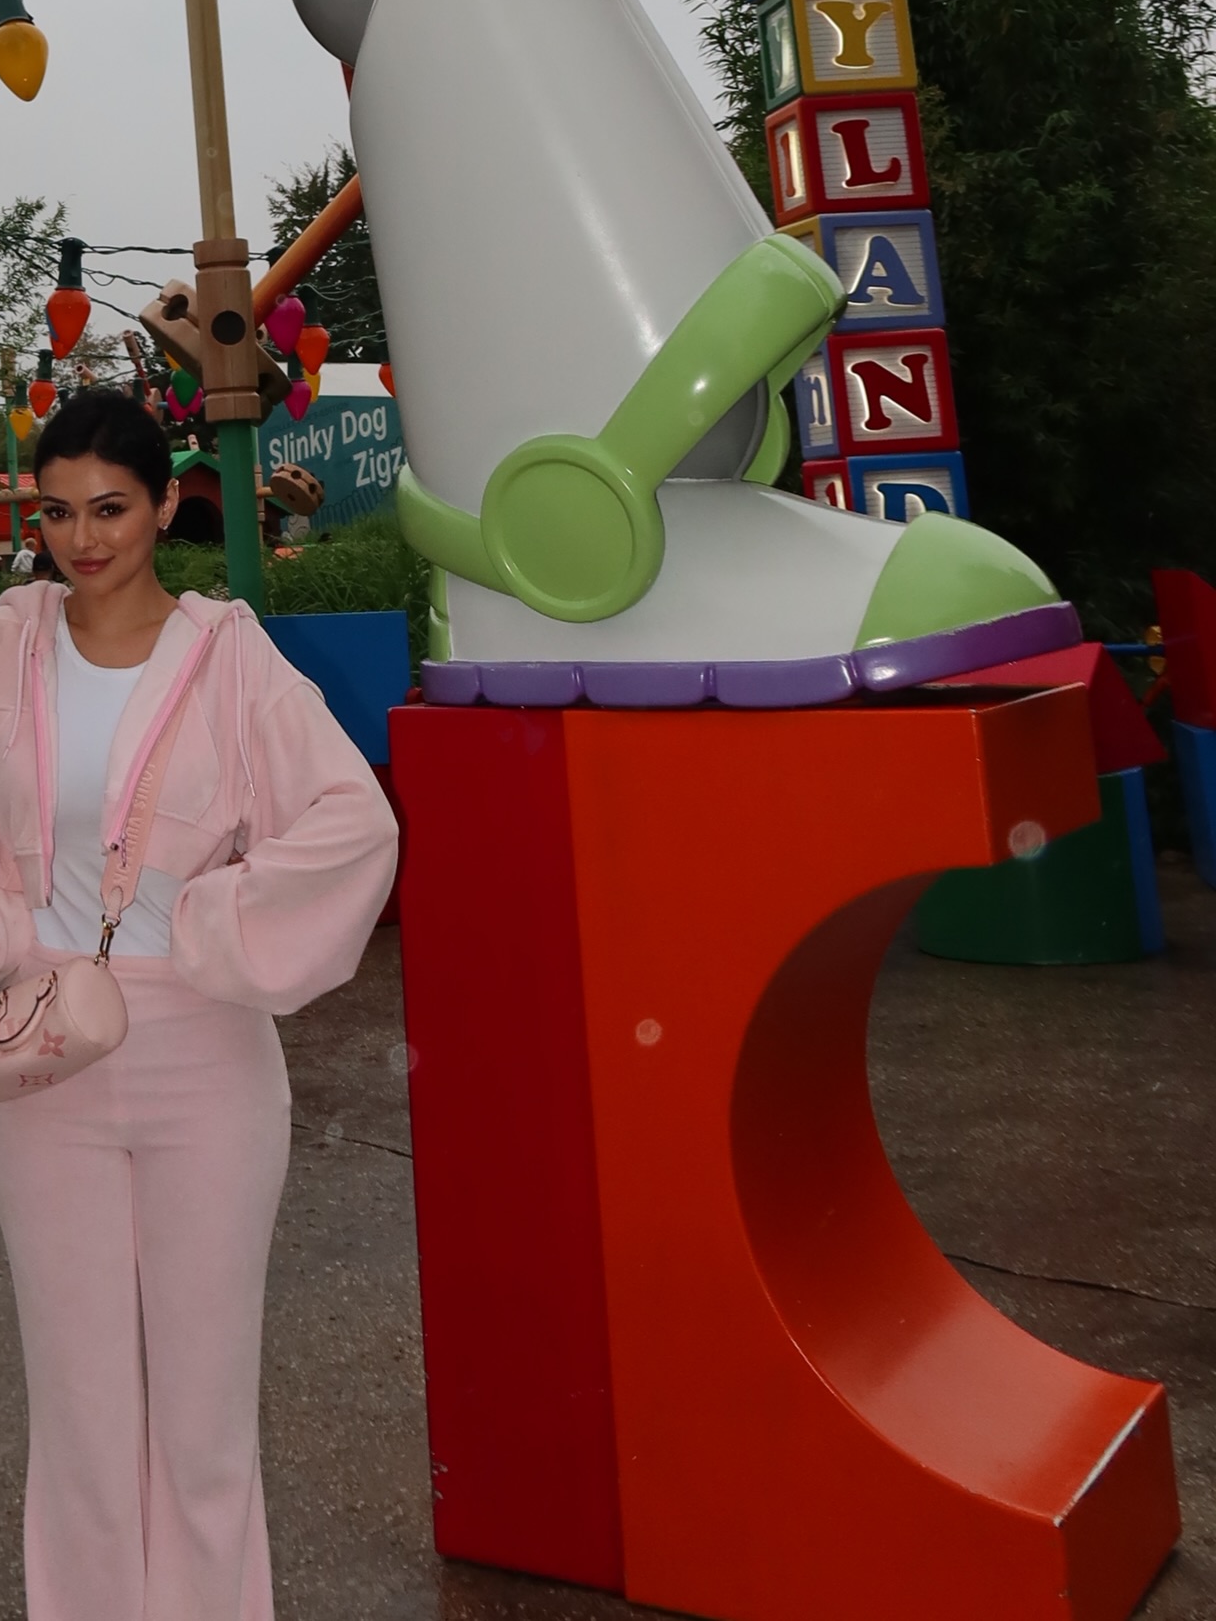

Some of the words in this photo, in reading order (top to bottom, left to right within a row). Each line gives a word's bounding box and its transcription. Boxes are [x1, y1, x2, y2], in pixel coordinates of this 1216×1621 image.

[268, 424, 334, 470] Slinky
[341, 406, 386, 444] Dog
[353, 446, 407, 488] Zigz
